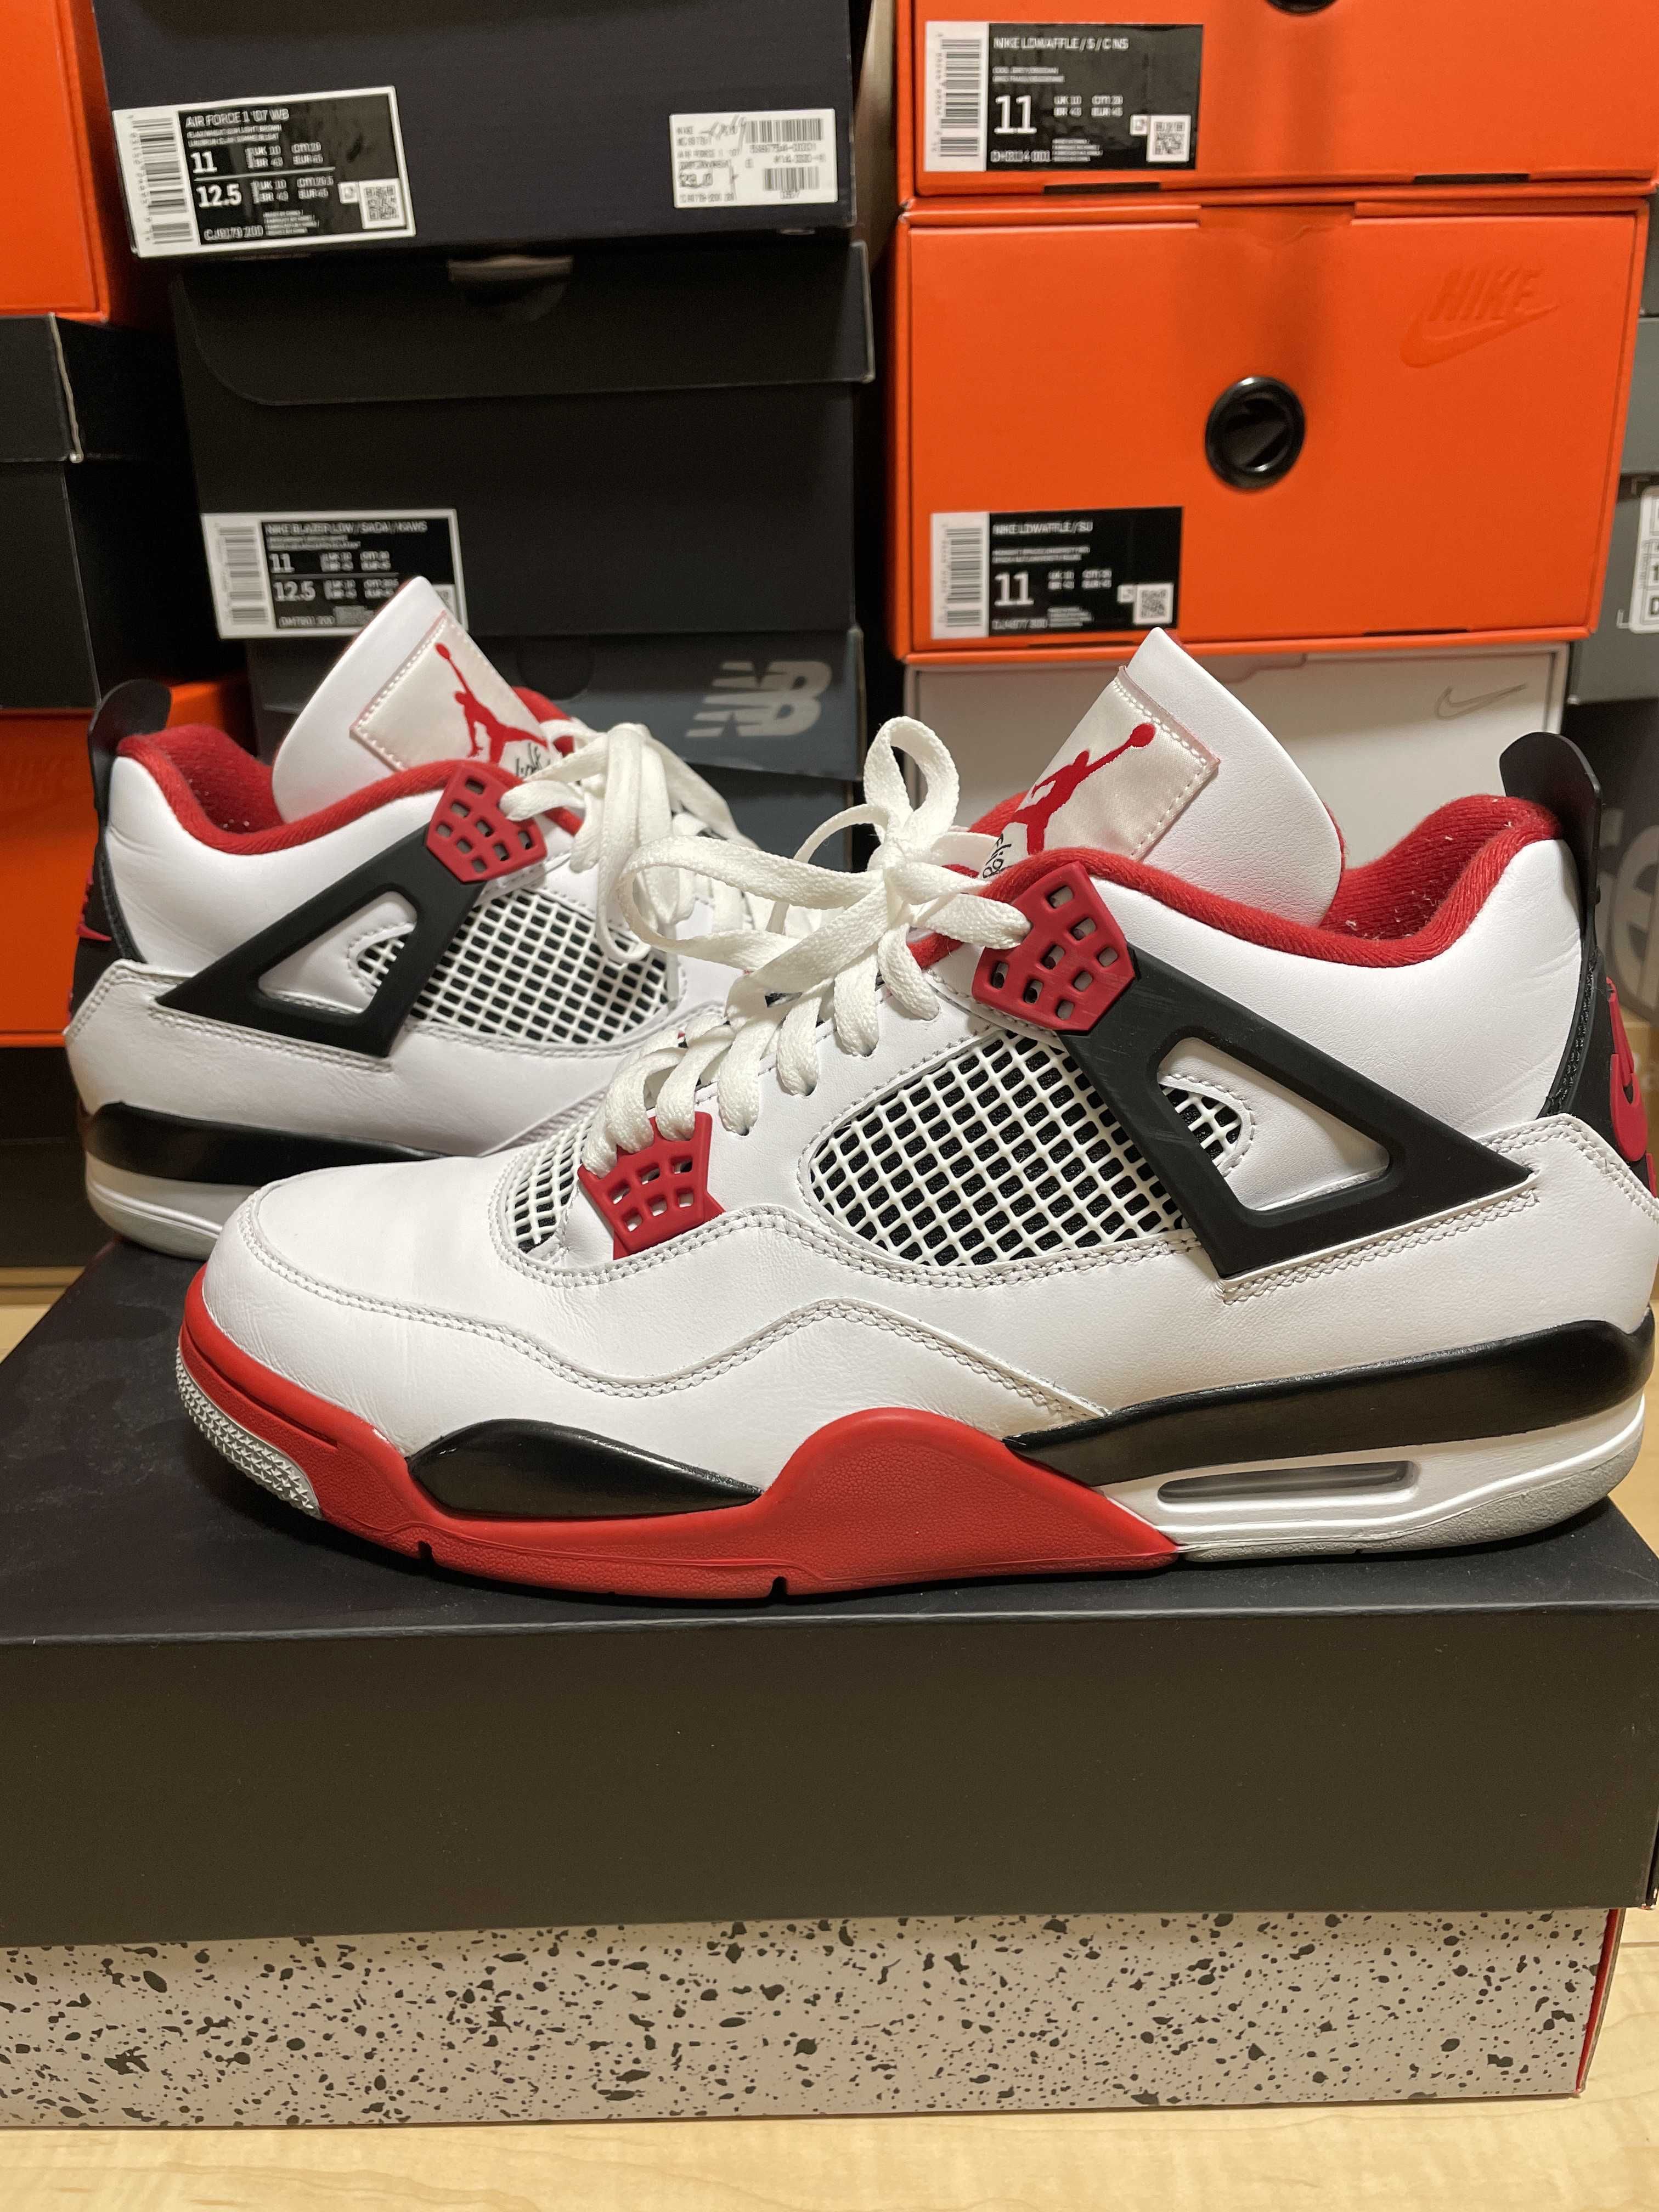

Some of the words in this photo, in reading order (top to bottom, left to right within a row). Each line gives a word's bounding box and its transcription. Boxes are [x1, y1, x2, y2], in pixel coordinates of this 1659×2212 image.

[994, 37, 1020, 49] NIKE
[185, 115, 205, 127] AIR
[205, 111, 241, 126] FORCE
[242, 111, 250, 123] 1
[994, 94, 1037, 134] 11
[190, 151, 217, 173] 11
[196, 183, 242, 208] 12.5
[1426, 265, 1544, 321] NIKE
[268, 553, 295, 573] 11
[273, 580, 316, 601] 12.5
[994, 572, 1034, 606] 11
